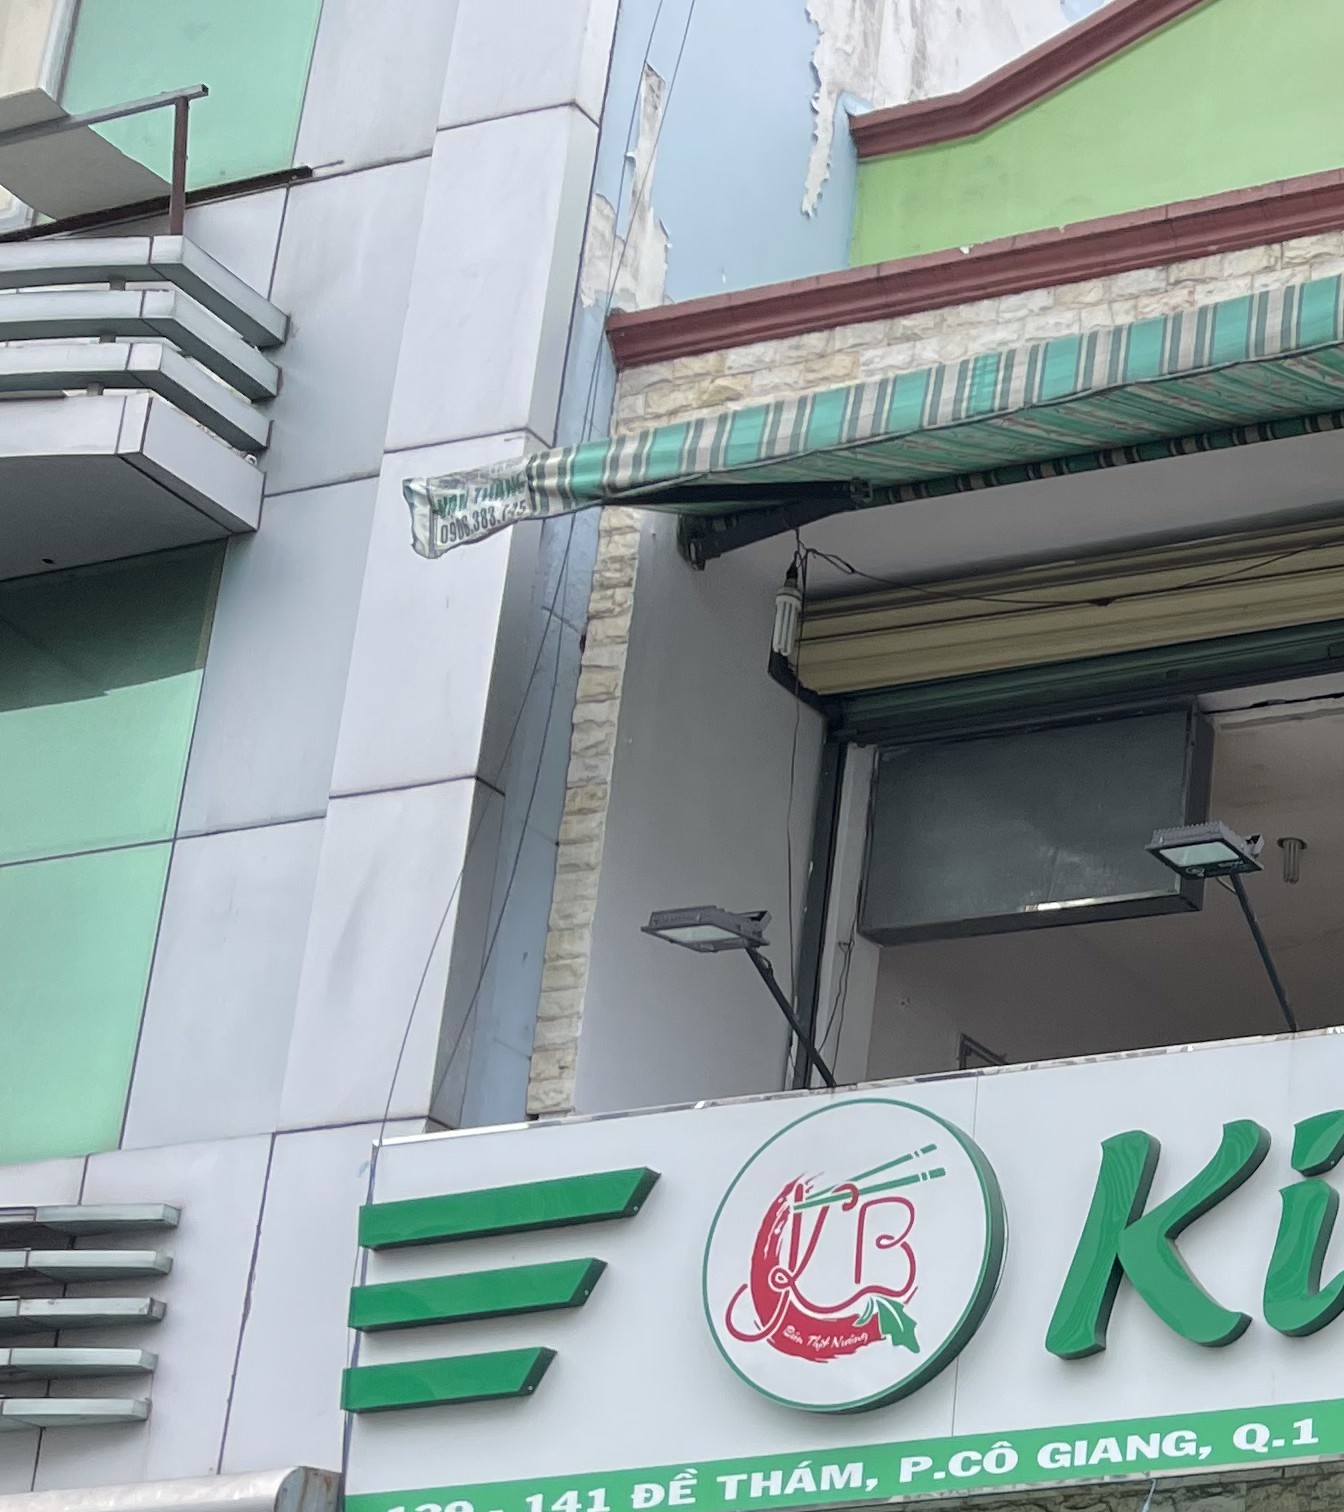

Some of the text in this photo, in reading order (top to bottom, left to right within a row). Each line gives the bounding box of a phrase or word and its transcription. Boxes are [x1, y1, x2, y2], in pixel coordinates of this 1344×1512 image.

[632, 1469, 697, 1508] ĐỀ
[717, 1461, 877, 1500] THÁM,
[900, 1441, 1018, 1482] P.CÔ
[1038, 1431, 1211, 1468] GIANG,
[1233, 1419, 1318, 1452] Q.1
